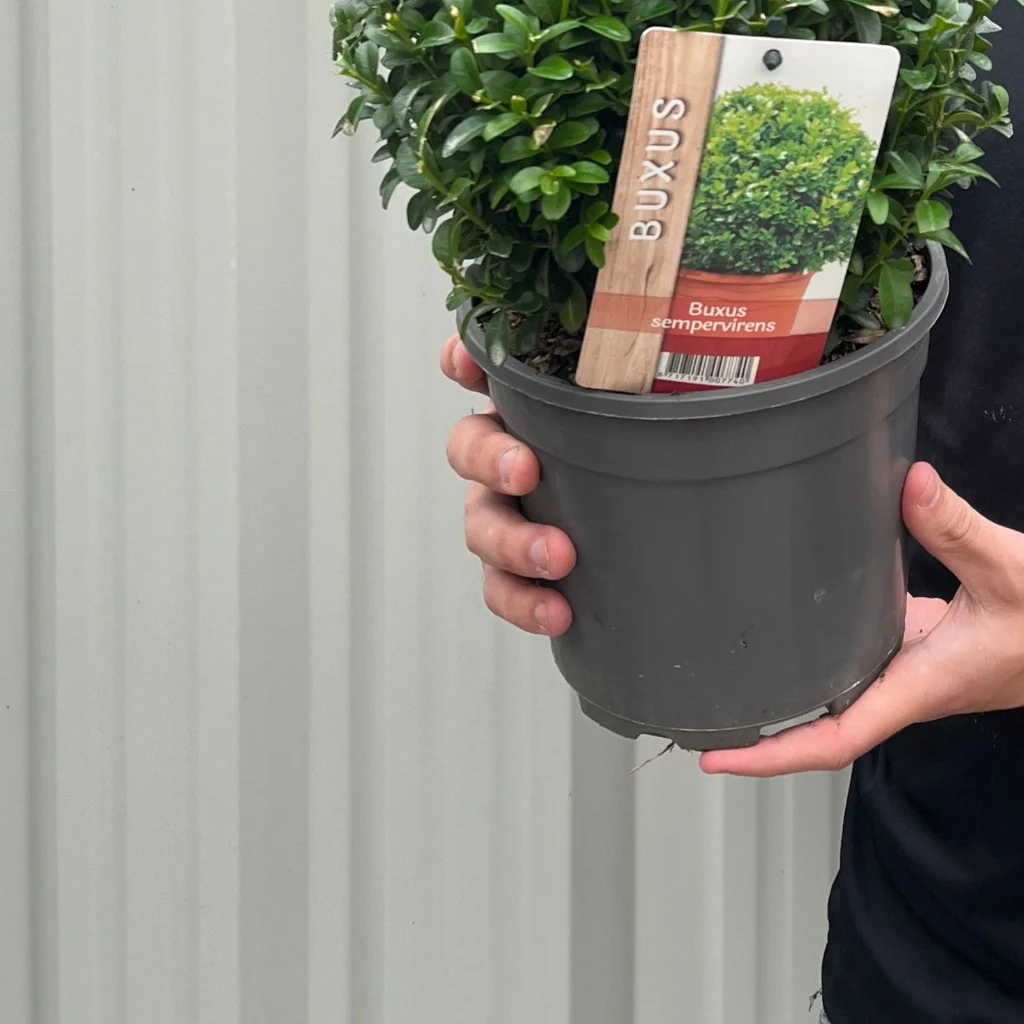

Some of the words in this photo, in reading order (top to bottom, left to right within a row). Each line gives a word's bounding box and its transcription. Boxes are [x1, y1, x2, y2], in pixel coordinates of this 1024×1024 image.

[629, 95, 687, 242] BUXUS
[688, 301, 748, 318] Buxus
[650, 317, 777, 335] sempervirens
